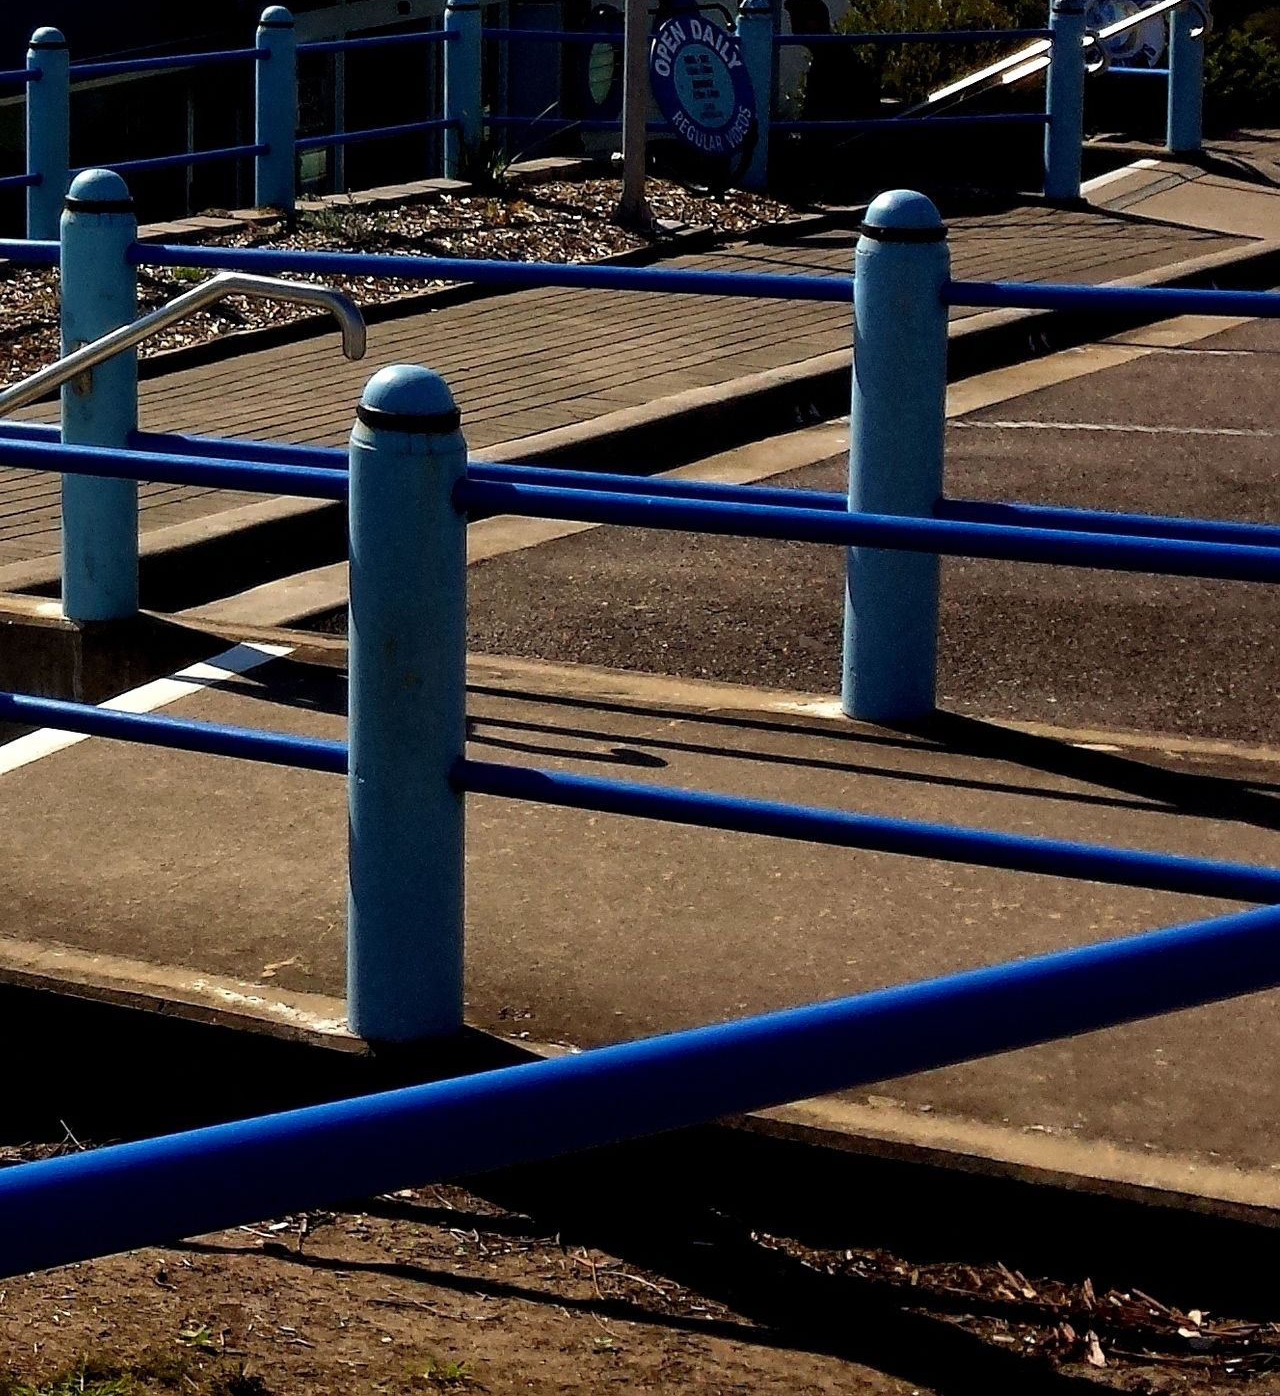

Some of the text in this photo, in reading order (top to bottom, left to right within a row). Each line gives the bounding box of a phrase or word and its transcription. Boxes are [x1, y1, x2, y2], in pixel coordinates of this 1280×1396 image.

[654, 18, 744, 77] OPEN DAILY
[671, 105, 753, 152] REGULAR VIDEOS
